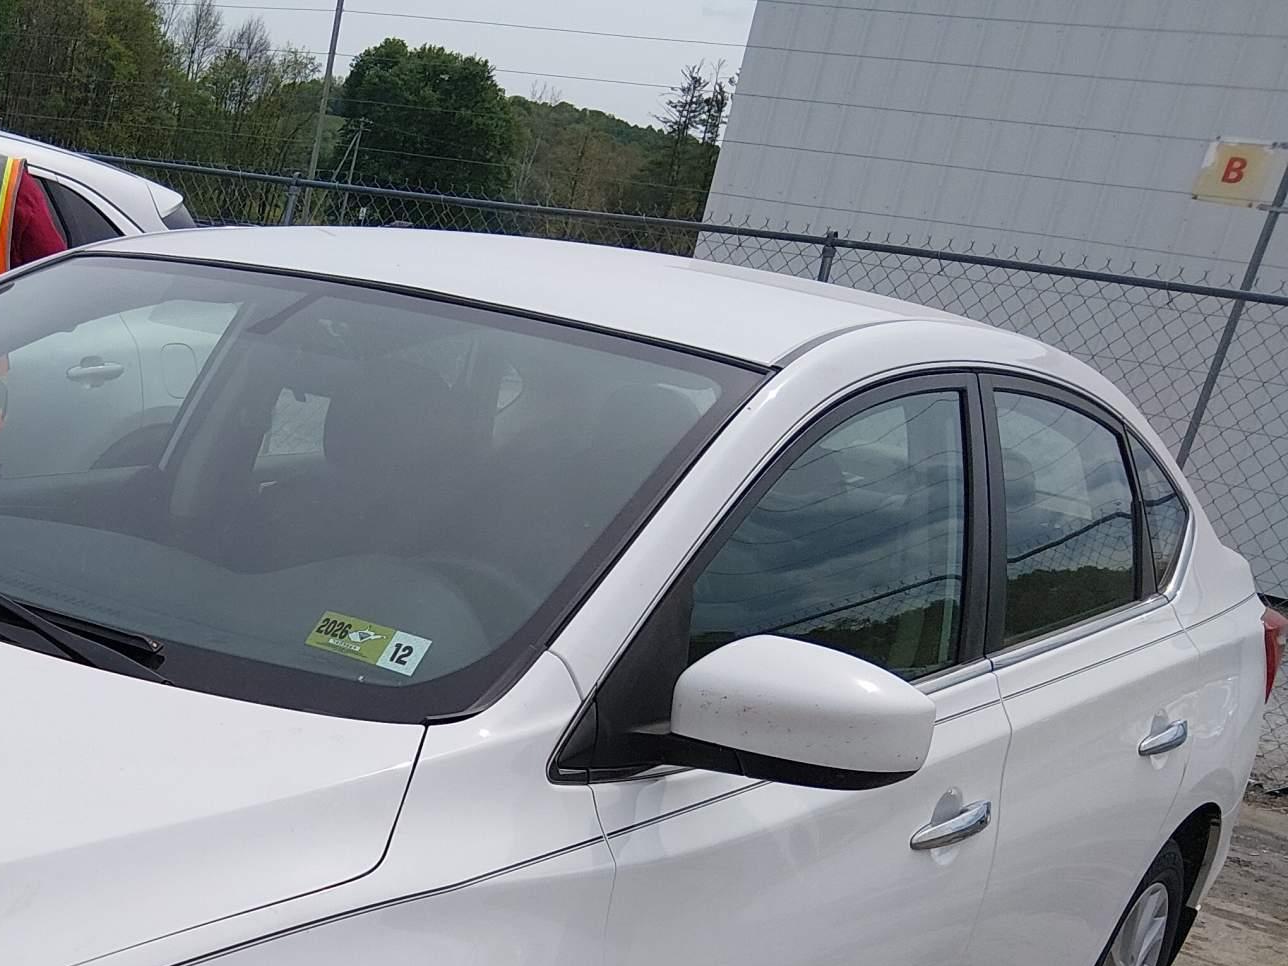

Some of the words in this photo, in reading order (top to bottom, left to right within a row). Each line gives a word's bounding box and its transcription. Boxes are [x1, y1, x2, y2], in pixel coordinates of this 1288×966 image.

[1221, 156, 1248, 184] B
[315, 617, 352, 640] 2026
[388, 642, 414, 666] 12
